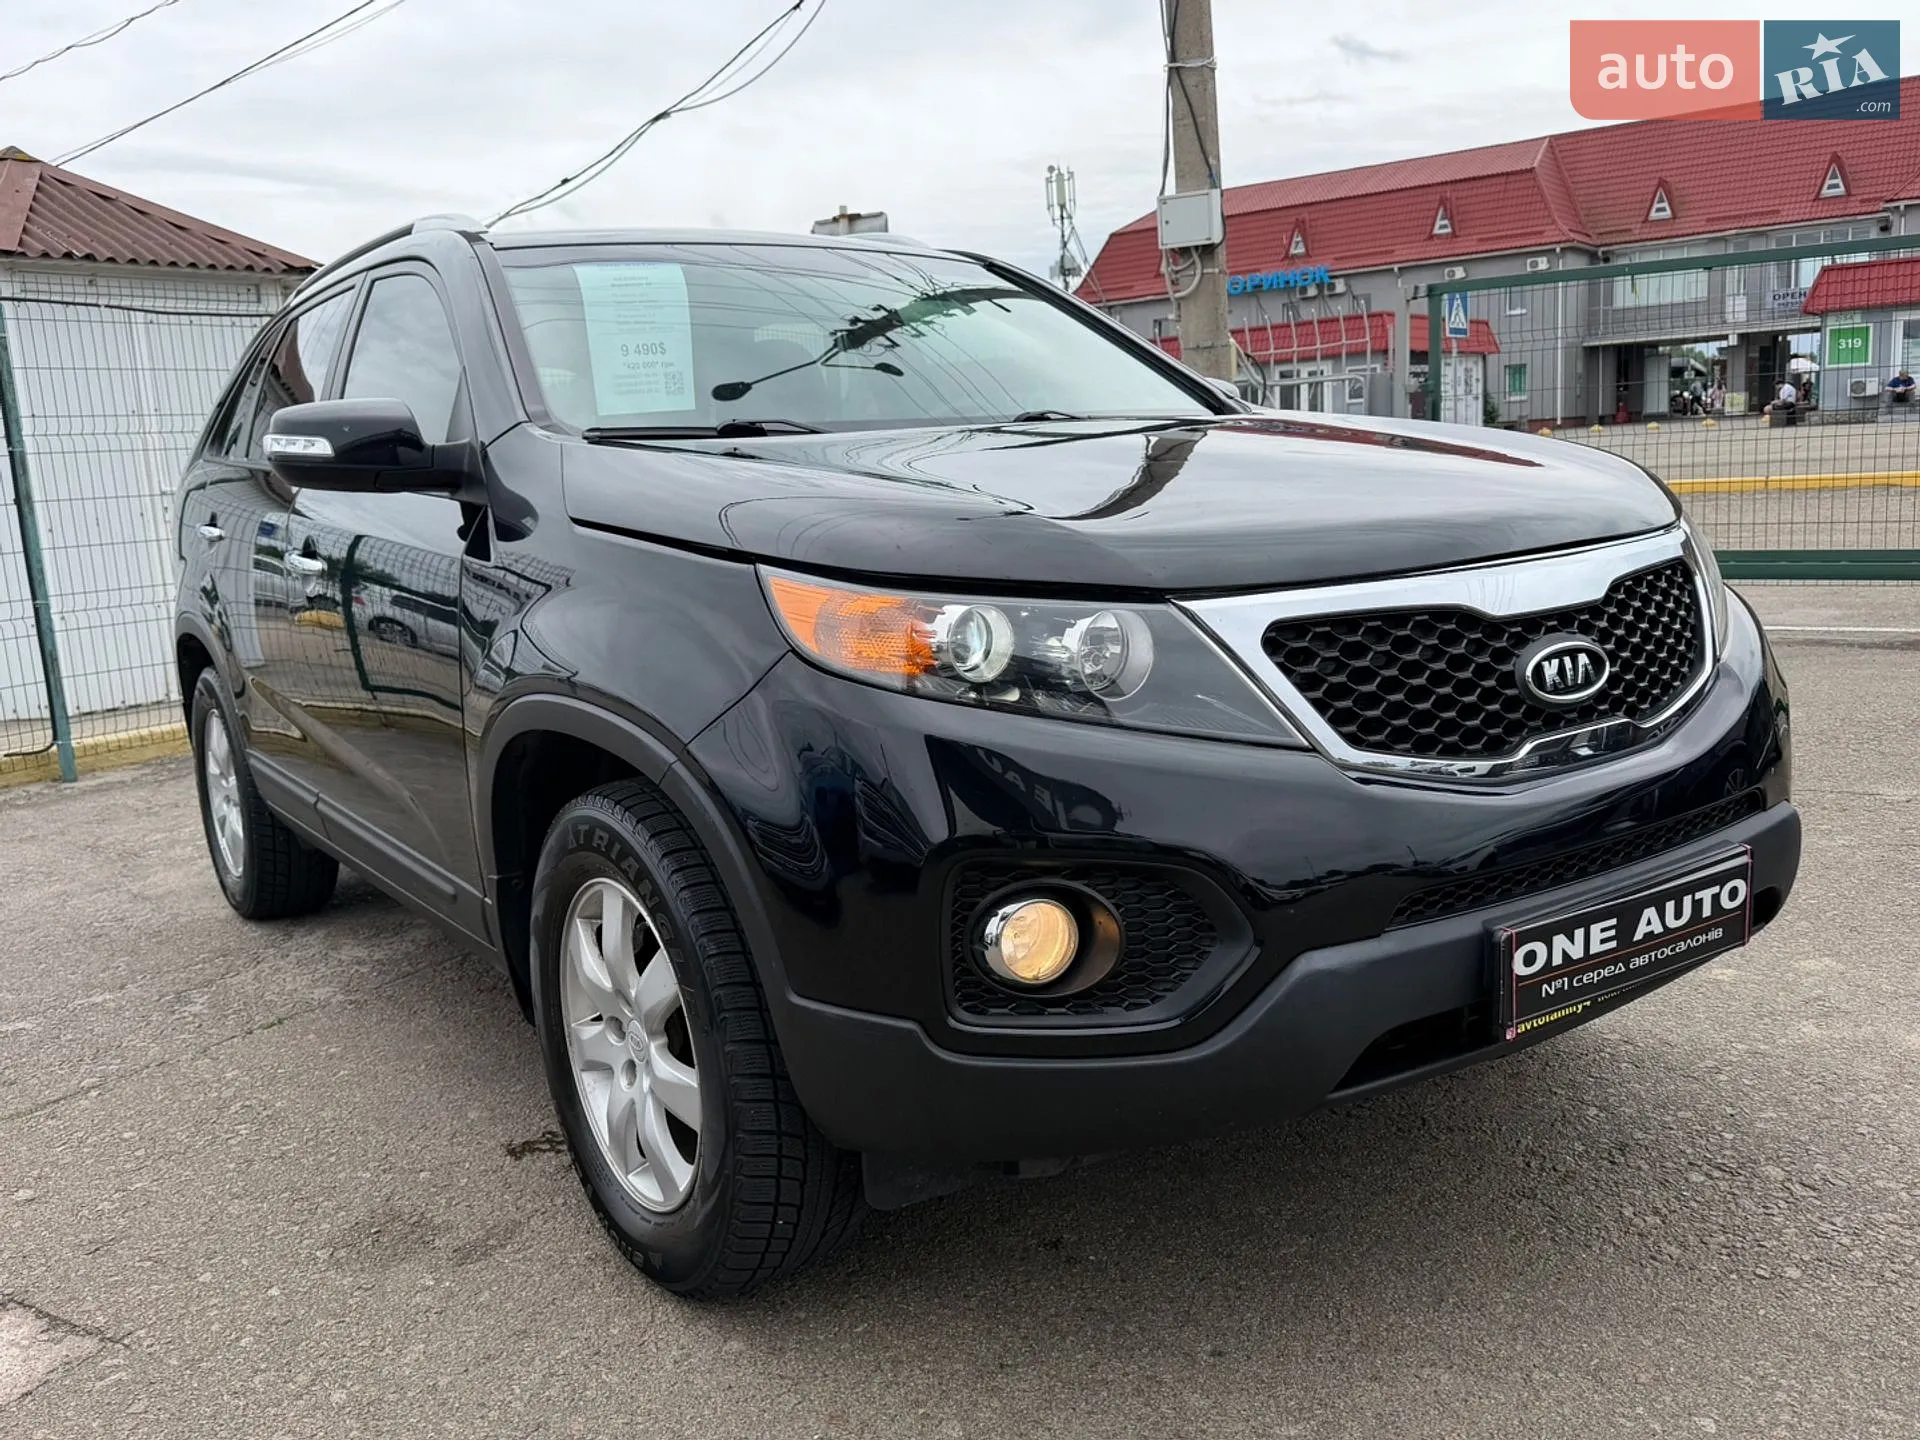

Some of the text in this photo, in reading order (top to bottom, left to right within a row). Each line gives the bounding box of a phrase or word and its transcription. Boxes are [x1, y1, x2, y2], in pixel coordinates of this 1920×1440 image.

[1227, 264, 1331, 296] ОРИНОК
[620, 341, 667, 357] 9 490$
[1838, 337, 1862, 349] 319
[1541, 652, 1597, 692] KIA
[1512, 878, 1748, 976] ONE AUTO
[1572, 961, 1626, 987] серед
[1629, 927, 1723, 970] автосалонів
